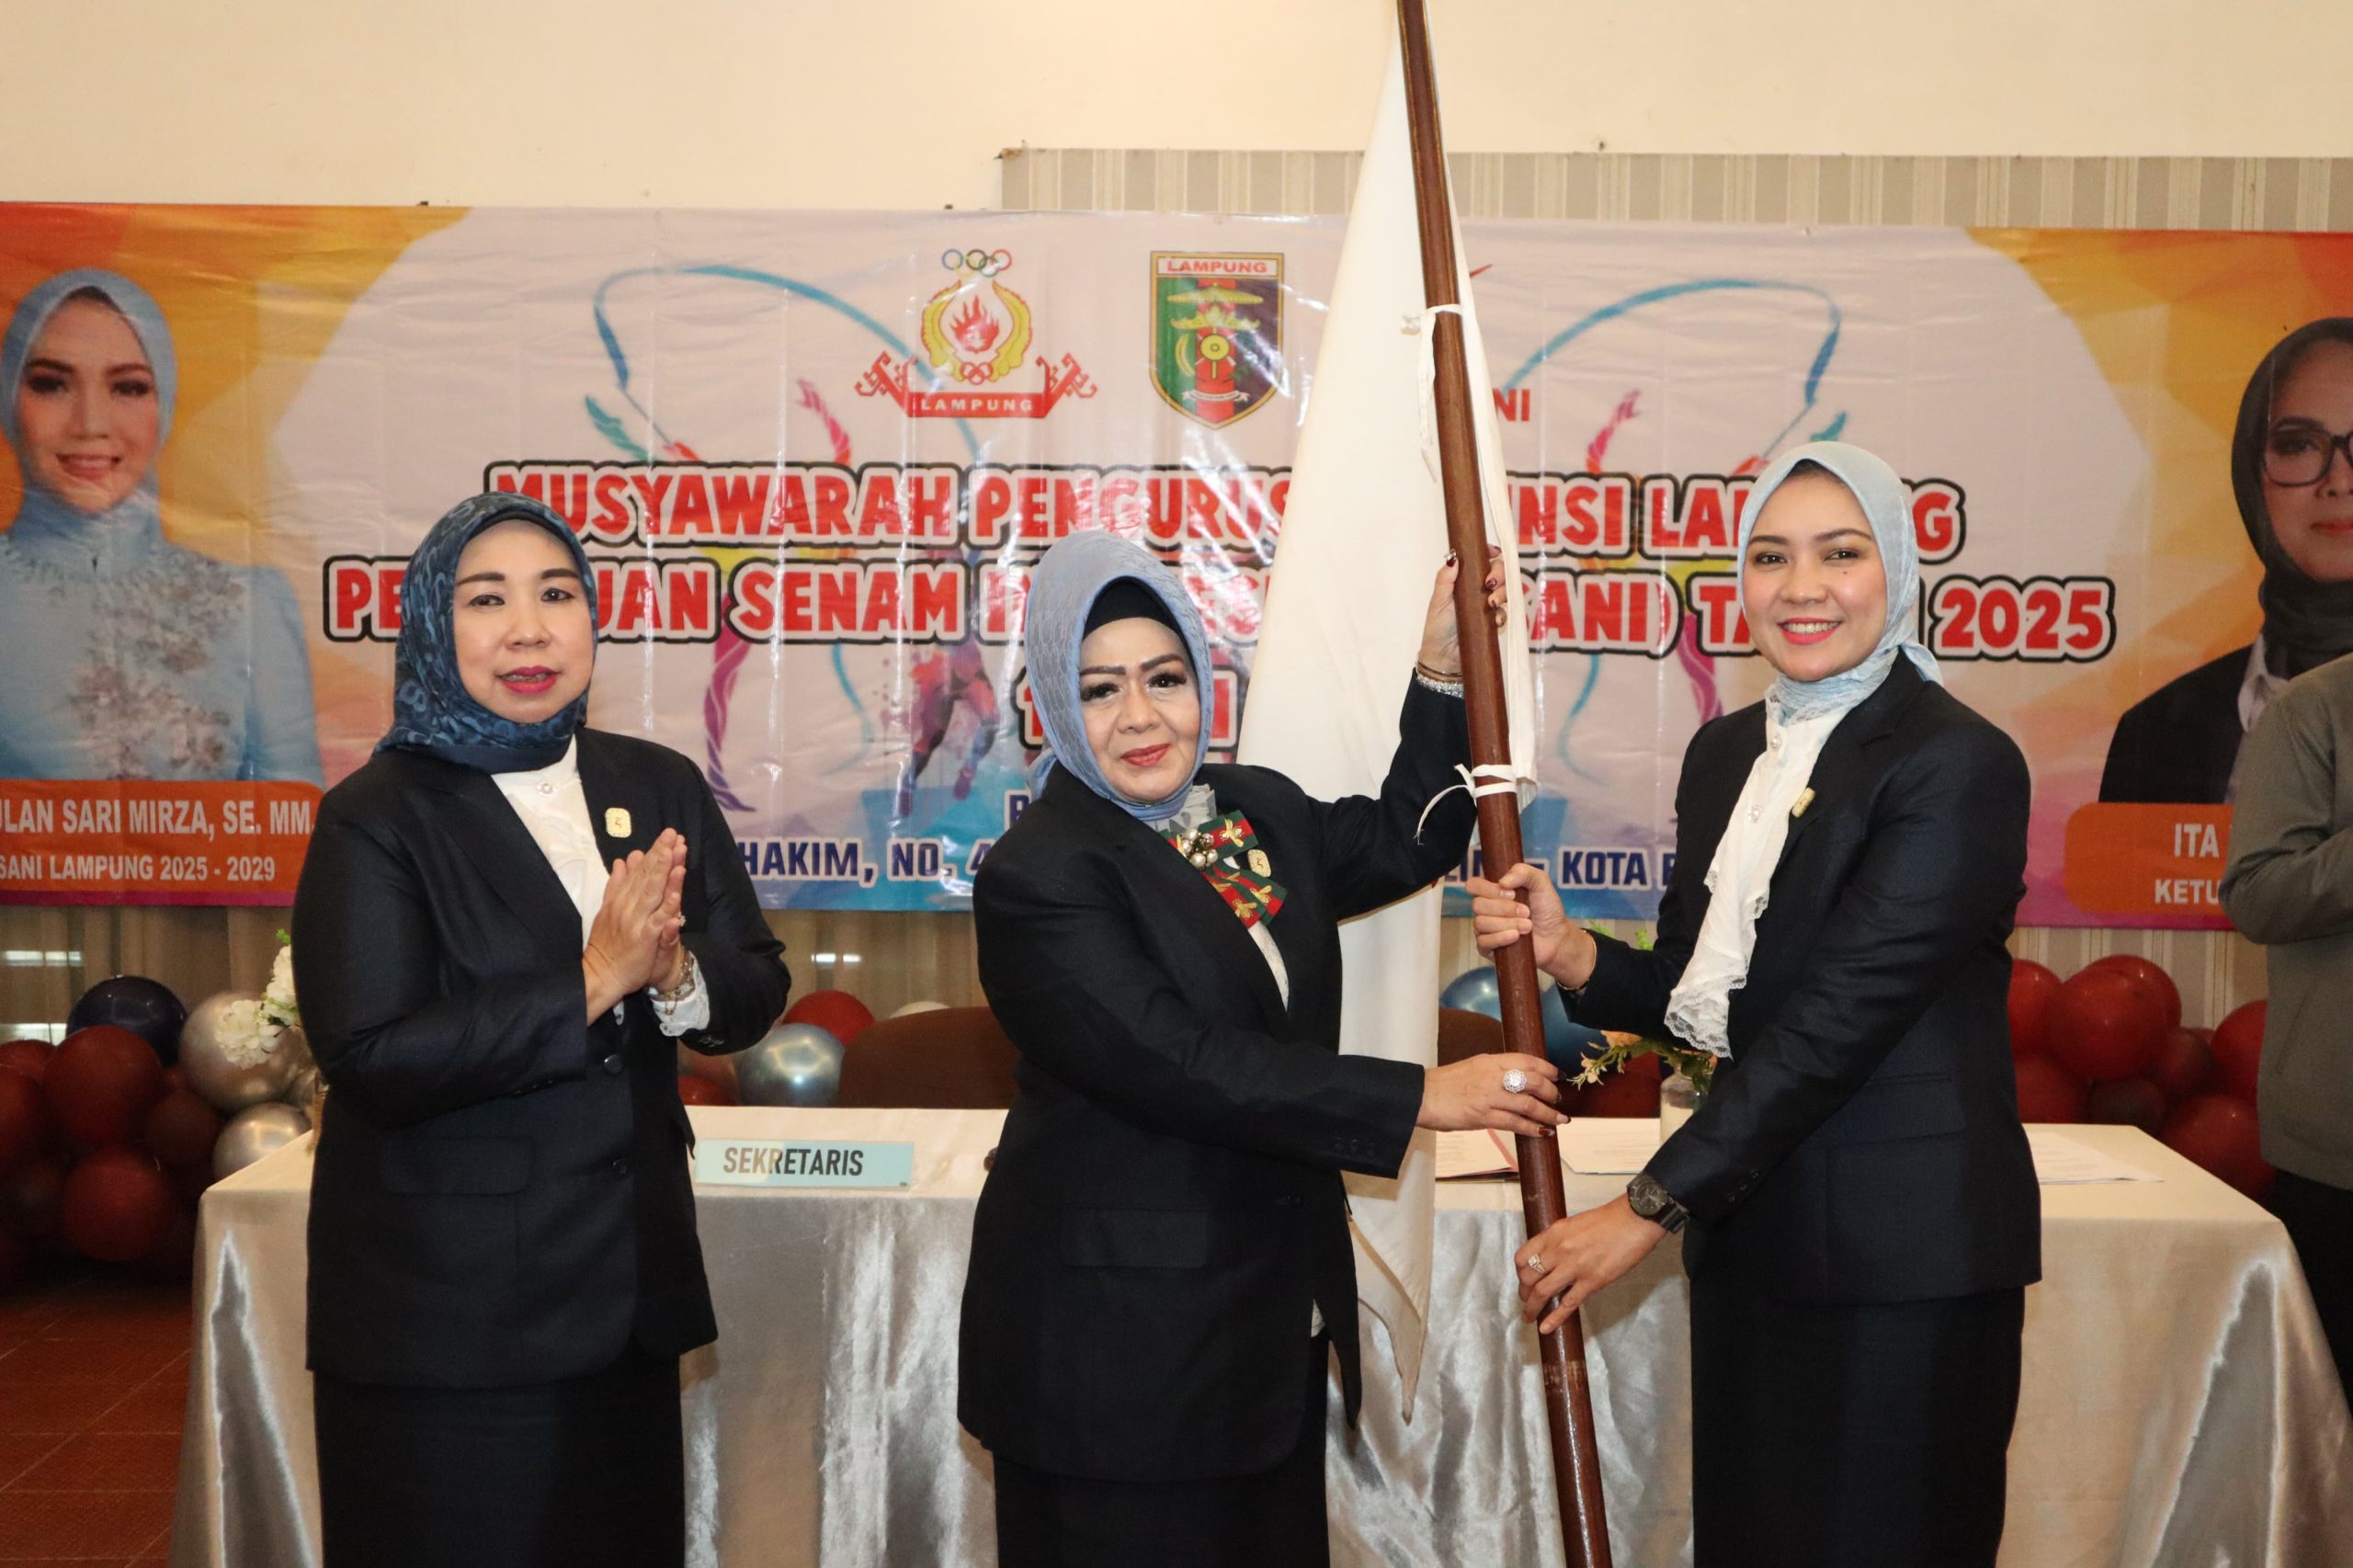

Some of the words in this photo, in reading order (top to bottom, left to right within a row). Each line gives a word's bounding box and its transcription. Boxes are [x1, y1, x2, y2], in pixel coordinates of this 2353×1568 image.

[1166, 260, 1267, 273] LAMPUNG
[920, 398, 1033, 412] LAMPUNG
[738, 570, 959, 632] SENAM
[1940, 587, 2104, 651] 2025
[0, 799, 53, 833] LAN
[62, 799, 121, 834] SARI
[129, 800, 215, 842] MIRZA,
[222, 800, 262, 835] SE.
[2174, 823, 2219, 858] ITA
[50, 855, 153, 881] LAMPUNG
[160, 856, 208, 881] 2025
[226, 856, 276, 881] 2029
[738, 842, 874, 882] HAKIM,
[892, 843, 952, 877] NO.
[1563, 850, 1648, 886] KOTA
[2154, 879, 2222, 904] KETU
[723, 1146, 864, 1176] SEKRETARIS
